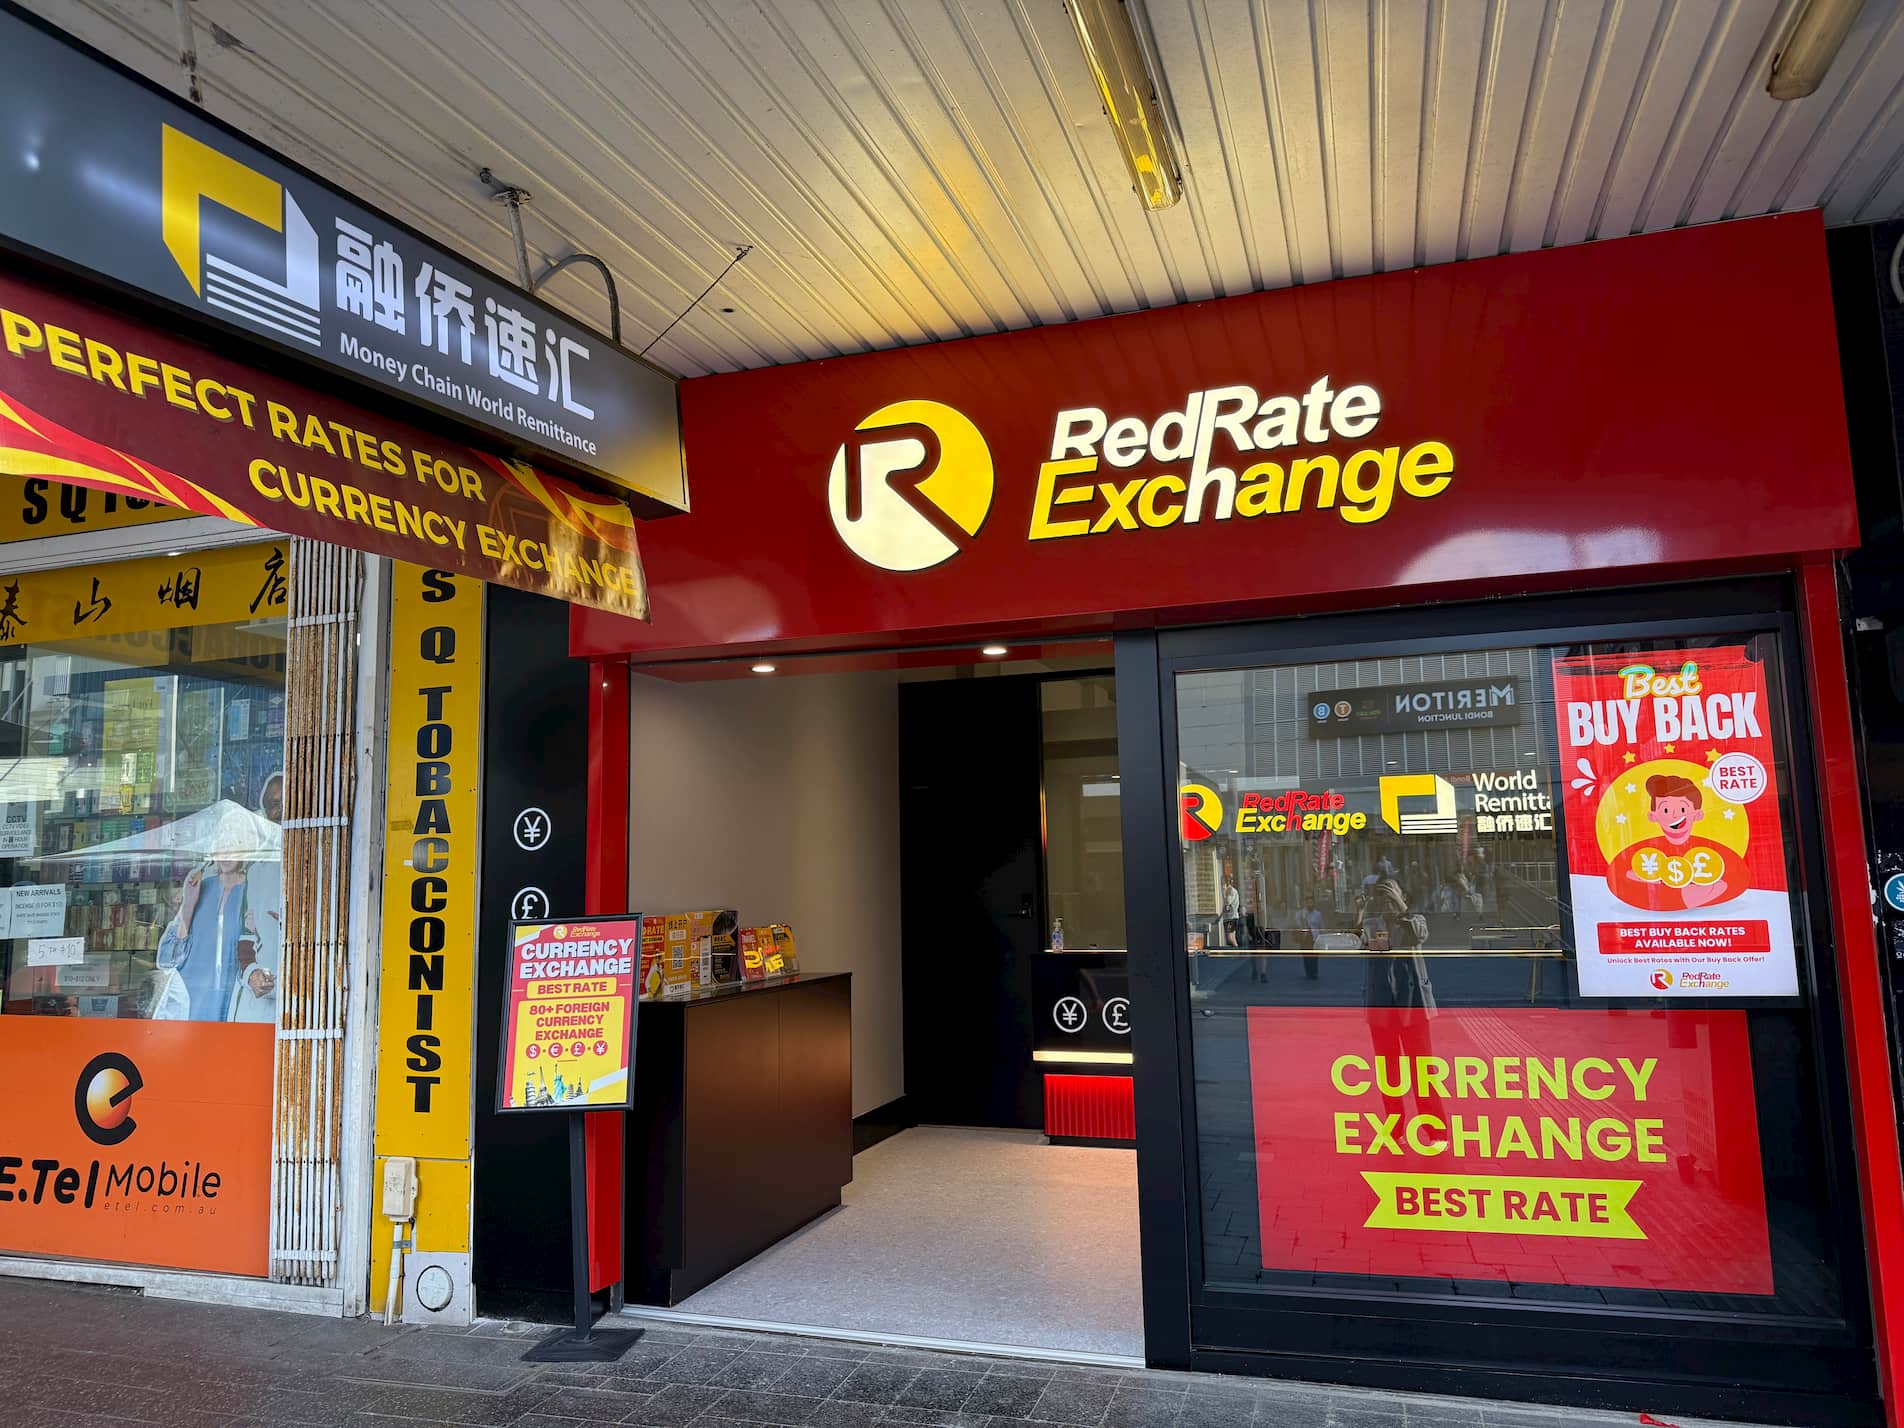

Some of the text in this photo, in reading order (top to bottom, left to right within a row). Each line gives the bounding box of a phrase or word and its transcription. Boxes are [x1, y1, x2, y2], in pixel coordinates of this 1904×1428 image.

[335, 217, 594, 420] 融侨速汇
[0, 308, 486, 501] PERFECT RATES FOR
[340, 333, 596, 455] Money Chain World Remittance
[1050, 374, 1381, 467] RedRate
[1029, 441, 1454, 540] Exchange
[248, 459, 637, 595] CURRENCY EXCHANGE
[1618, 661, 1703, 699] Best
[1567, 692, 1762, 746] BUY BACK
[1472, 769, 1537, 791] World
[1720, 766, 1755, 777] BEST
[1720, 779, 1757, 790] RATE
[1243, 790, 1345, 812] RedRate
[1235, 807, 1366, 835] Exchange
[406, 686, 453, 1112] TOBACCONIST
[1620, 926, 1745, 938] BEST BUY BACK RATES
[1635, 938, 1732, 949] AVAILABLE NOW!
[521, 938, 633, 960] CURRENCY
[519, 957, 632, 979] EXCHANGE
[1681, 972, 1720, 980] RedRate
[537, 981, 608, 995] BEST RATE
[1679, 979, 1729, 989] Exchange
[529, 1002, 610, 1015] 80+ FOREIGN
[536, 1014, 604, 1027] CURRENCY
[535, 1028, 604, 1041] EXCHANGE
[1330, 1053, 1659, 1102] CURRENCY
[1333, 1112, 1667, 1164] EXCHANGE
[105, 1160, 221, 1199] Mobile
[1394, 1186, 1610, 1225] BEST RATE
